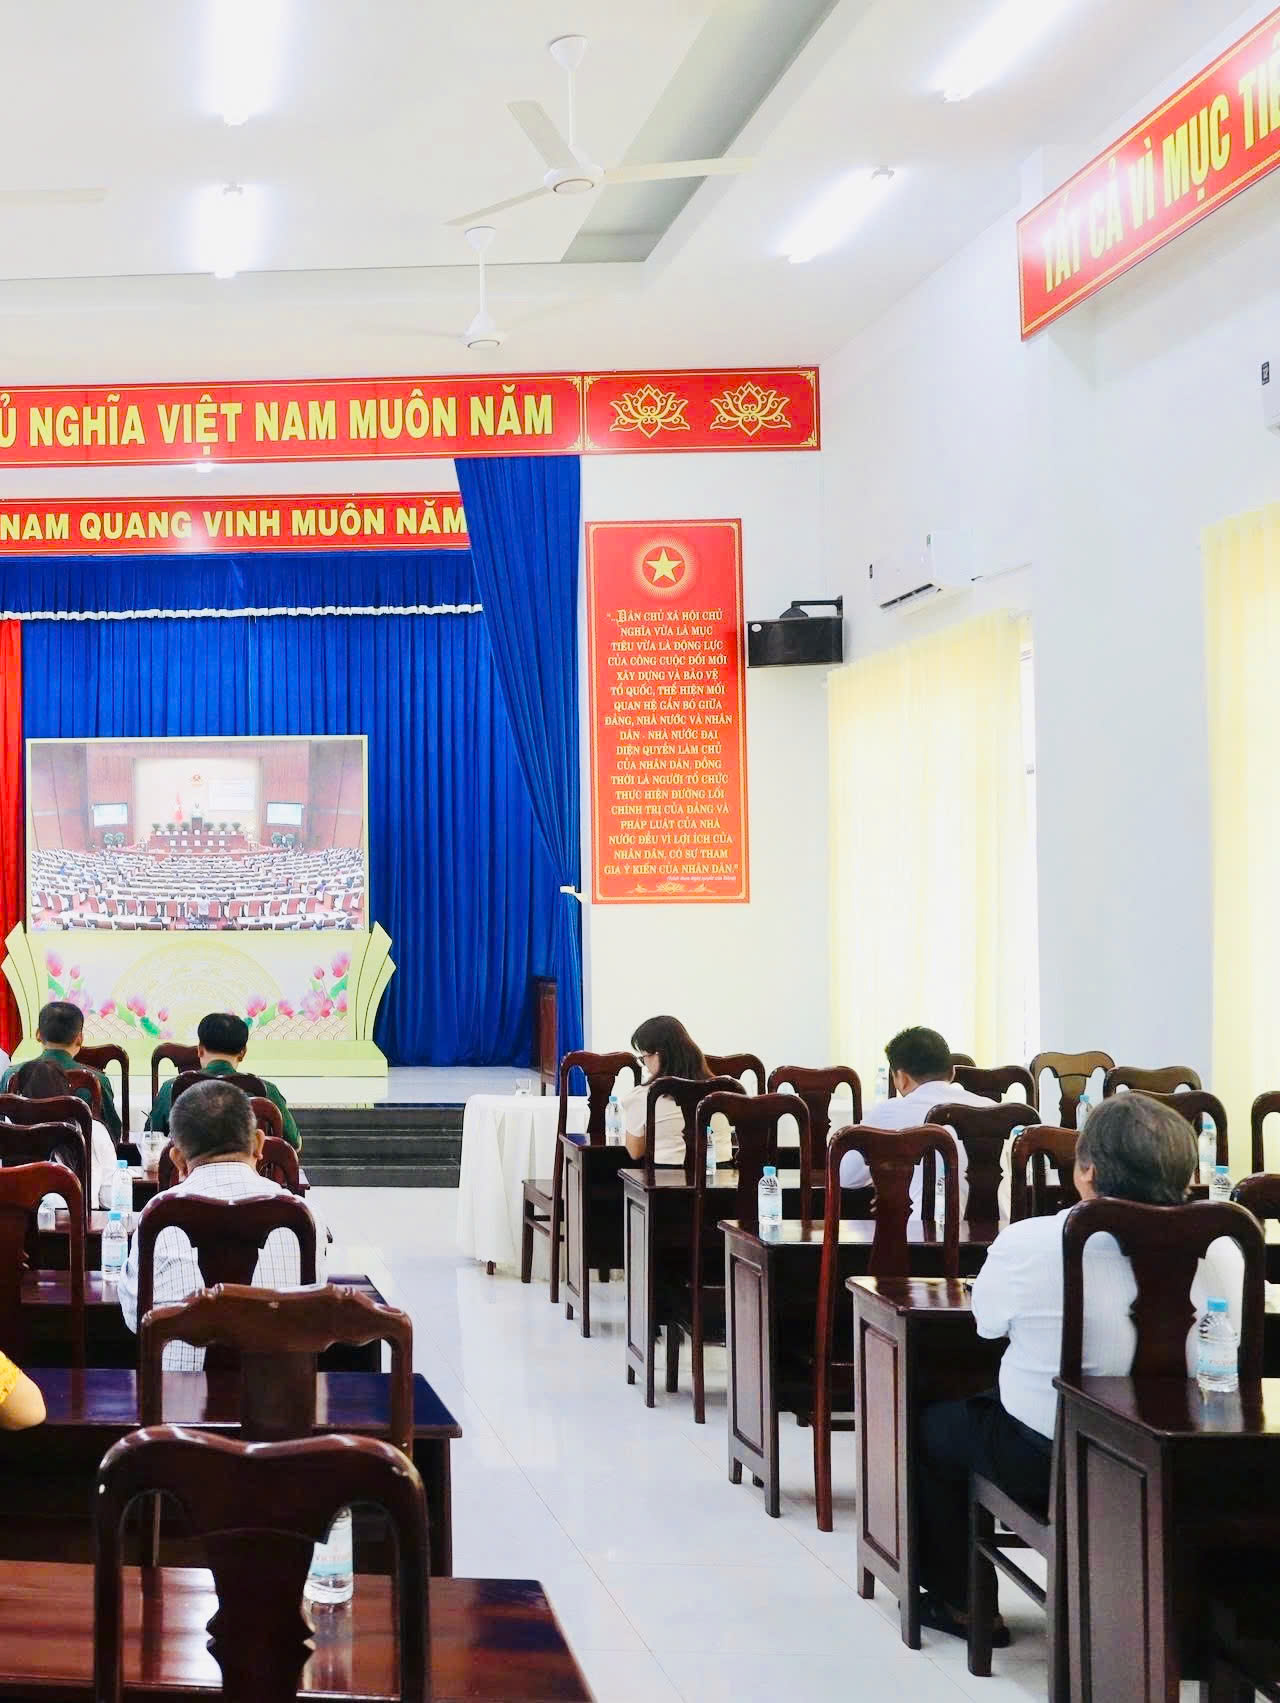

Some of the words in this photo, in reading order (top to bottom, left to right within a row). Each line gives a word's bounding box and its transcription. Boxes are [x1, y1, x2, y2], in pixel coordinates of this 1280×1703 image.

[1088, 156, 1123, 259] CẢ
[1128, 136, 1155, 230] VÌ
[1162, 94, 1231, 208] MỤC
[29, 393, 146, 447] NGHĨA
[157, 393, 242, 456] VIỆT
[255, 400, 336, 442] NAM
[349, 388, 457, 439] MUÔN
[470, 383, 553, 436] NĂM
[0, 513, 69, 542] NAM
[79, 511, 192, 541] QUANG
[202, 509, 280, 537] VINH
[291, 502, 385, 537] MUÔN
[396, 500, 468, 534] NĂM
